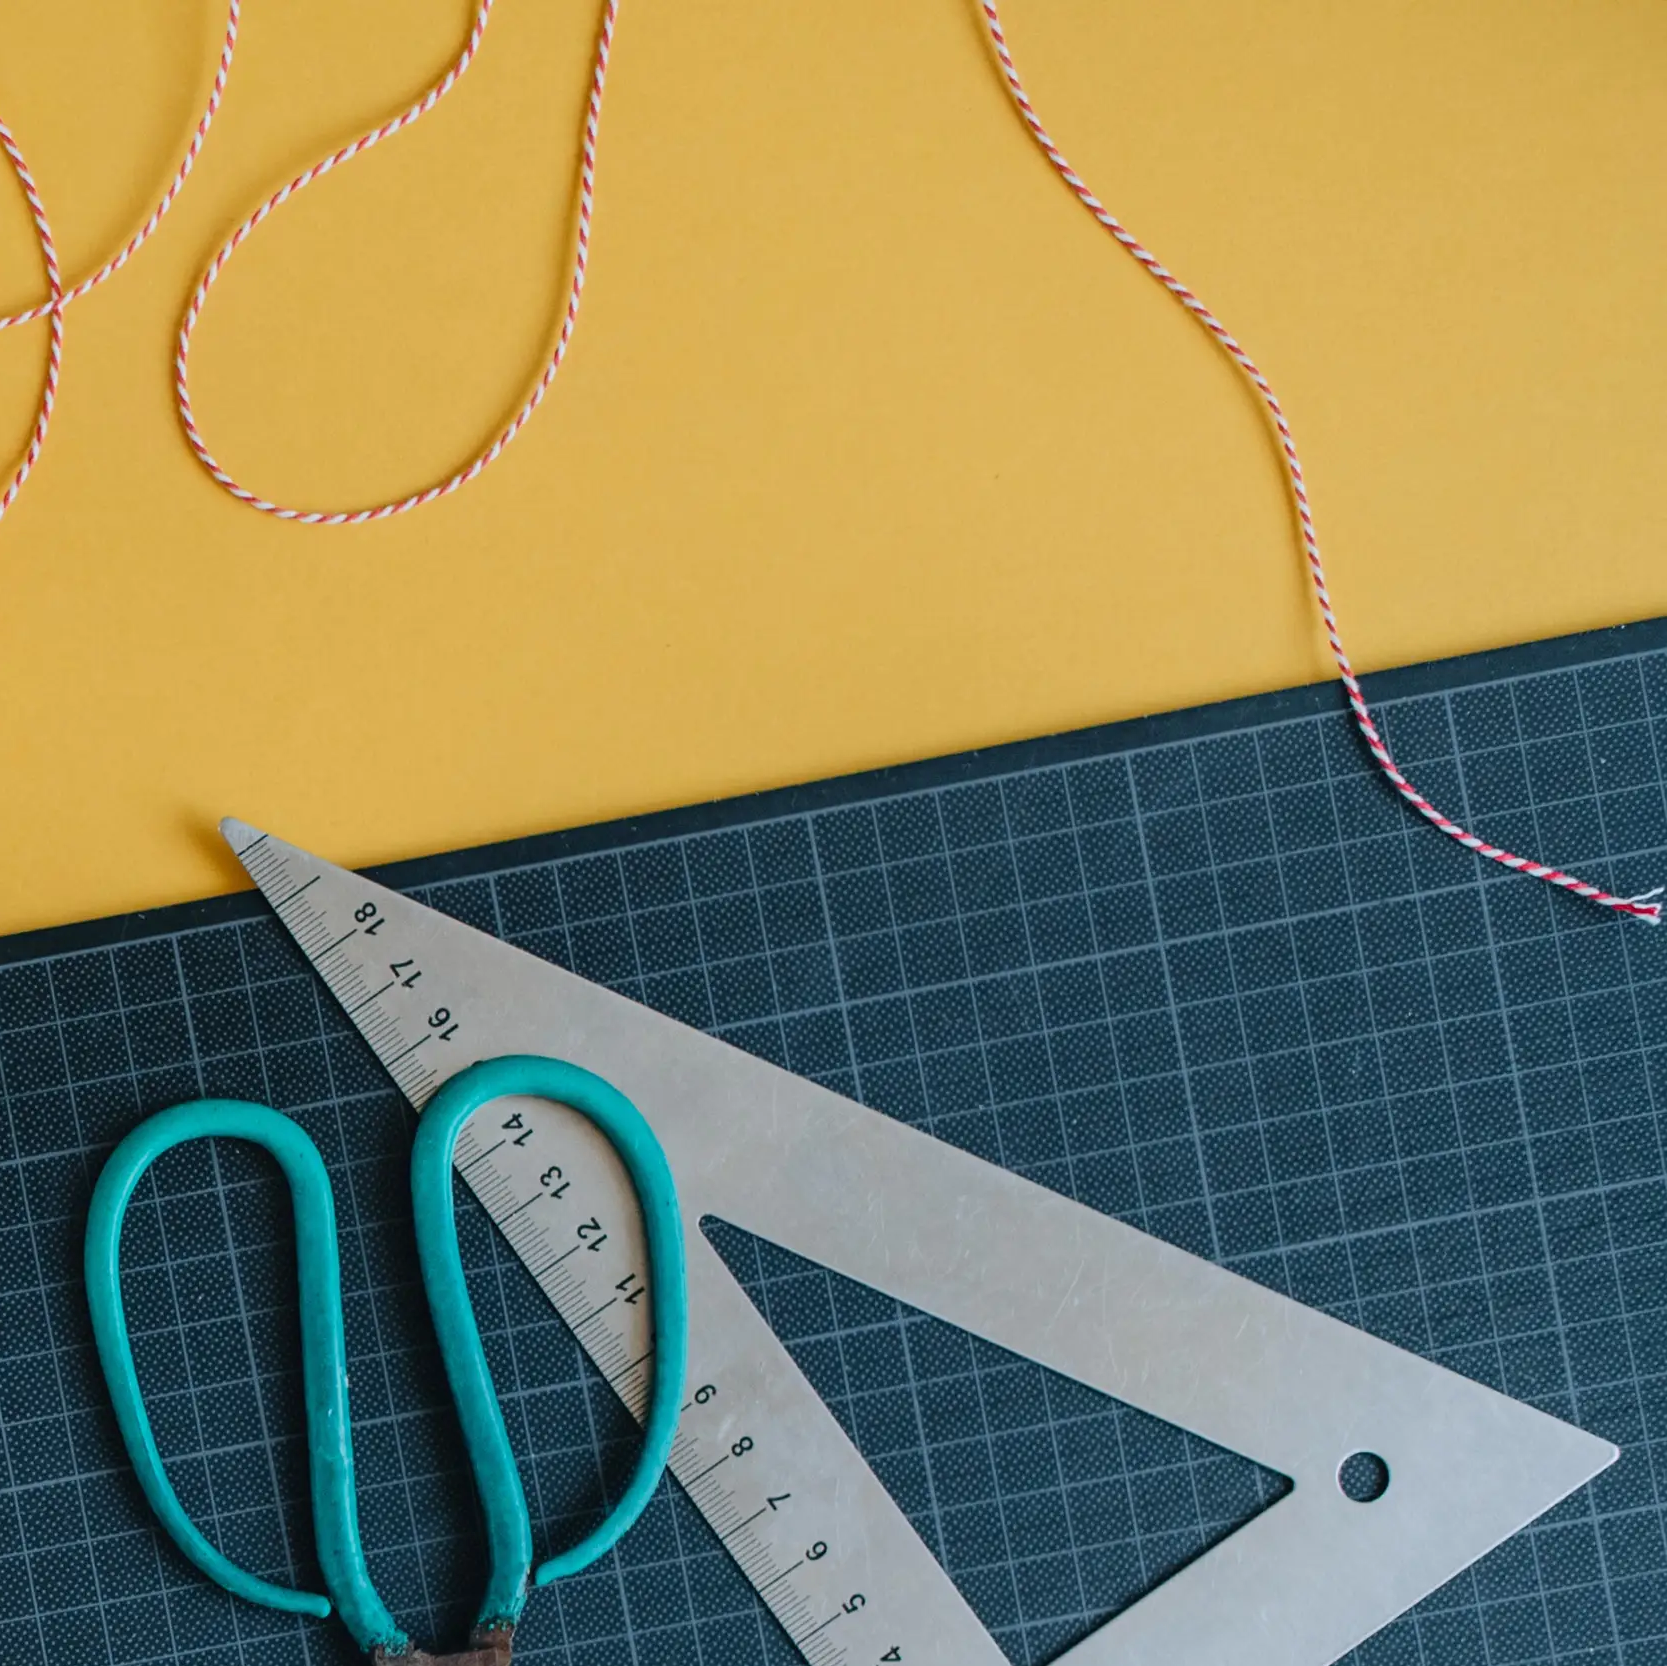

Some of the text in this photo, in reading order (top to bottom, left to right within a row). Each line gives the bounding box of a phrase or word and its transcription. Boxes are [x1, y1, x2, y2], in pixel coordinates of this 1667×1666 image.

[354, 902, 386, 936] 18
[389, 958, 424, 990] 17
[428, 1007, 460, 1042] 16
[501, 1112, 534, 1147] 14
[540, 1165, 571, 1199] 13
[577, 1217, 608, 1253] 12
[615, 1273, 646, 1306] 11
[694, 1383, 717, 1405] 9
[731, 1435, 754, 1457] 8
[766, 1492, 791, 1511] 7
[805, 1540, 828, 1562] 6
[842, 1593, 866, 1615] 5
[879, 1645, 902, 1666] 4
